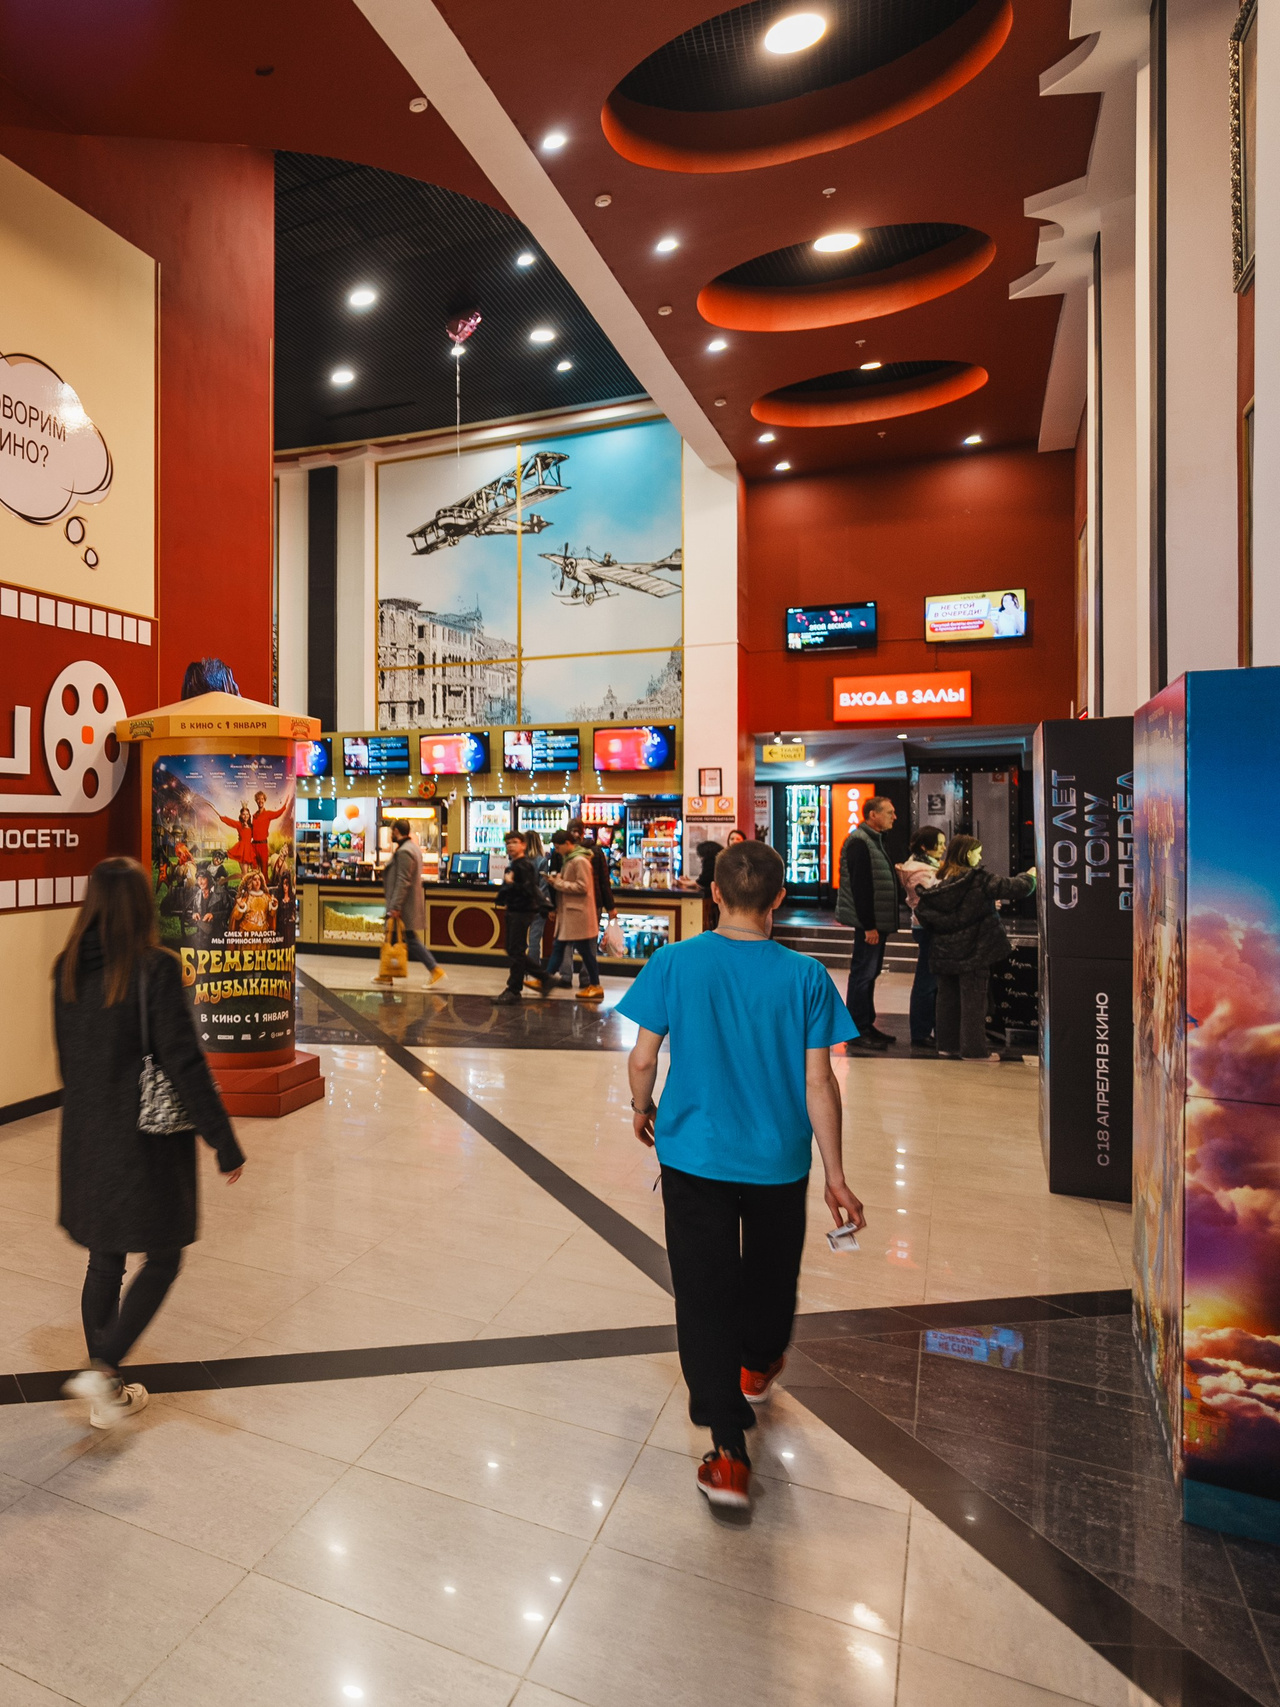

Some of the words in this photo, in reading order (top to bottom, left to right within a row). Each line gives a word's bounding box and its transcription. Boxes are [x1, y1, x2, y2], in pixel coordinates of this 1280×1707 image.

[953, 602, 975, 610] СТОЙ
[839, 691, 893, 707] ВХОД
[895, 690, 908, 705] В
[911, 687, 965, 704] ЗАЛЫ
[225, 721, 230, 729] 1
[233, 721, 267, 729] ЯНВАРЯ
[1051, 769, 1077, 834] ЛЕТ
[1084, 791, 1110, 886] ТОМУ
[1052, 840, 1078, 910] СТО
[250, 930, 276, 938] РАДОСТЬ
[194, 978, 292, 1005] МУЗЫКАНТЫ
[200, 1014, 208, 1022] В
[212, 1014, 241, 1023] КИНО
[245, 1014, 251, 1022] С
[254, 1012, 260, 1022] 1
[262, 1010, 289, 1022] ЯНВАРЯ
[1095, 992, 1109, 1040] КИНО
[1096, 1043, 1109, 1056] В
[1096, 1058, 1110, 1127] АПРЕЛЯ
[1097, 1130, 1110, 1151] 18
[1097, 1154, 1110, 1166] С
